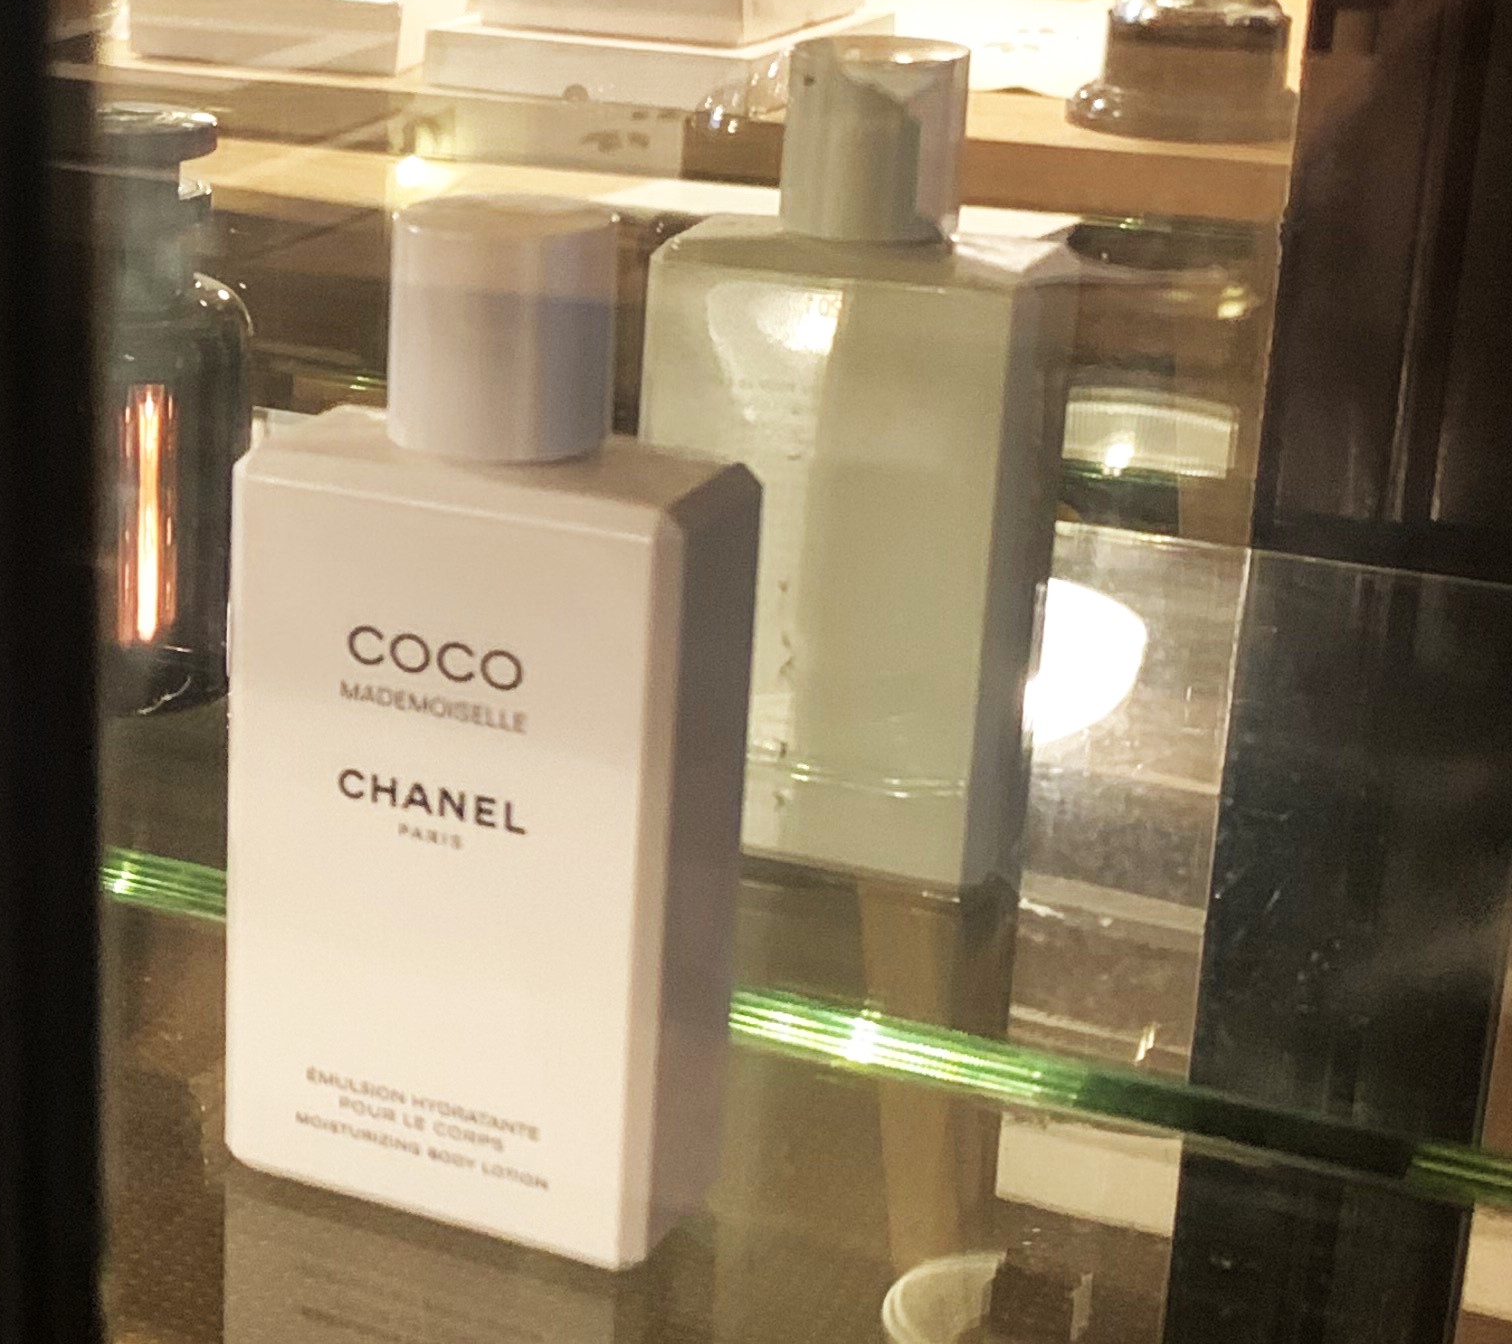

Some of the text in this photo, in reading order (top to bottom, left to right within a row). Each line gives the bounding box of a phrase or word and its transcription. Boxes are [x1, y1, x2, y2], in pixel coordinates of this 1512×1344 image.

[347, 625, 523, 691] COCO
[340, 679, 527, 735] MADEMOISELLE
[338, 769, 526, 835] CHANEL
[398, 823, 463, 850] PARIS
[338, 1095, 504, 1153] POUR LE CORPS
[411, 1094, 539, 1142] HYDRATANTE
[295, 1111, 420, 1156] MOISTURIZING
[481, 1161, 548, 1190] LOTION
